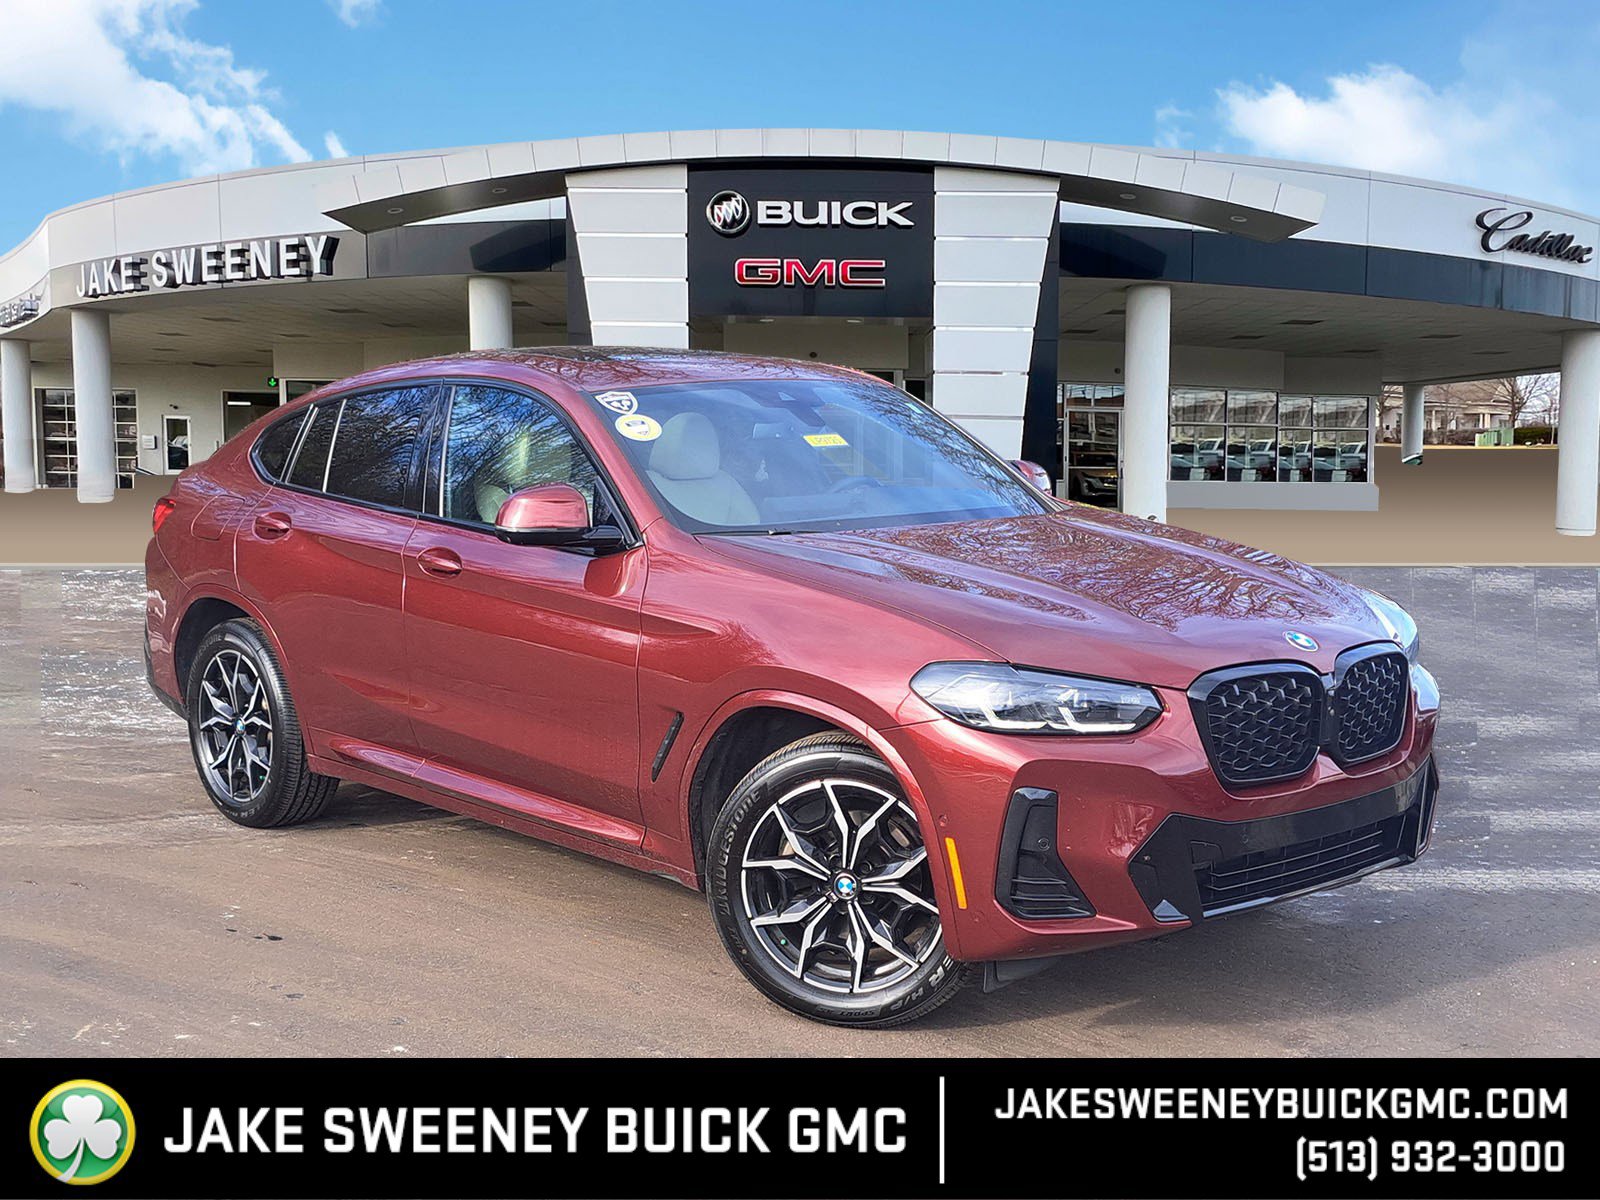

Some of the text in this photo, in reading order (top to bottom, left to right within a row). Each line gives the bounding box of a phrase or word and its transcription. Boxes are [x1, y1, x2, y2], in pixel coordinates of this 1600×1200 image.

[757, 200, 915, 226] BUICK
[1475, 207, 1593, 264] Cadillac
[76, 235, 331, 298] JAKE SWEENEY
[734, 258, 886, 287] GMC
